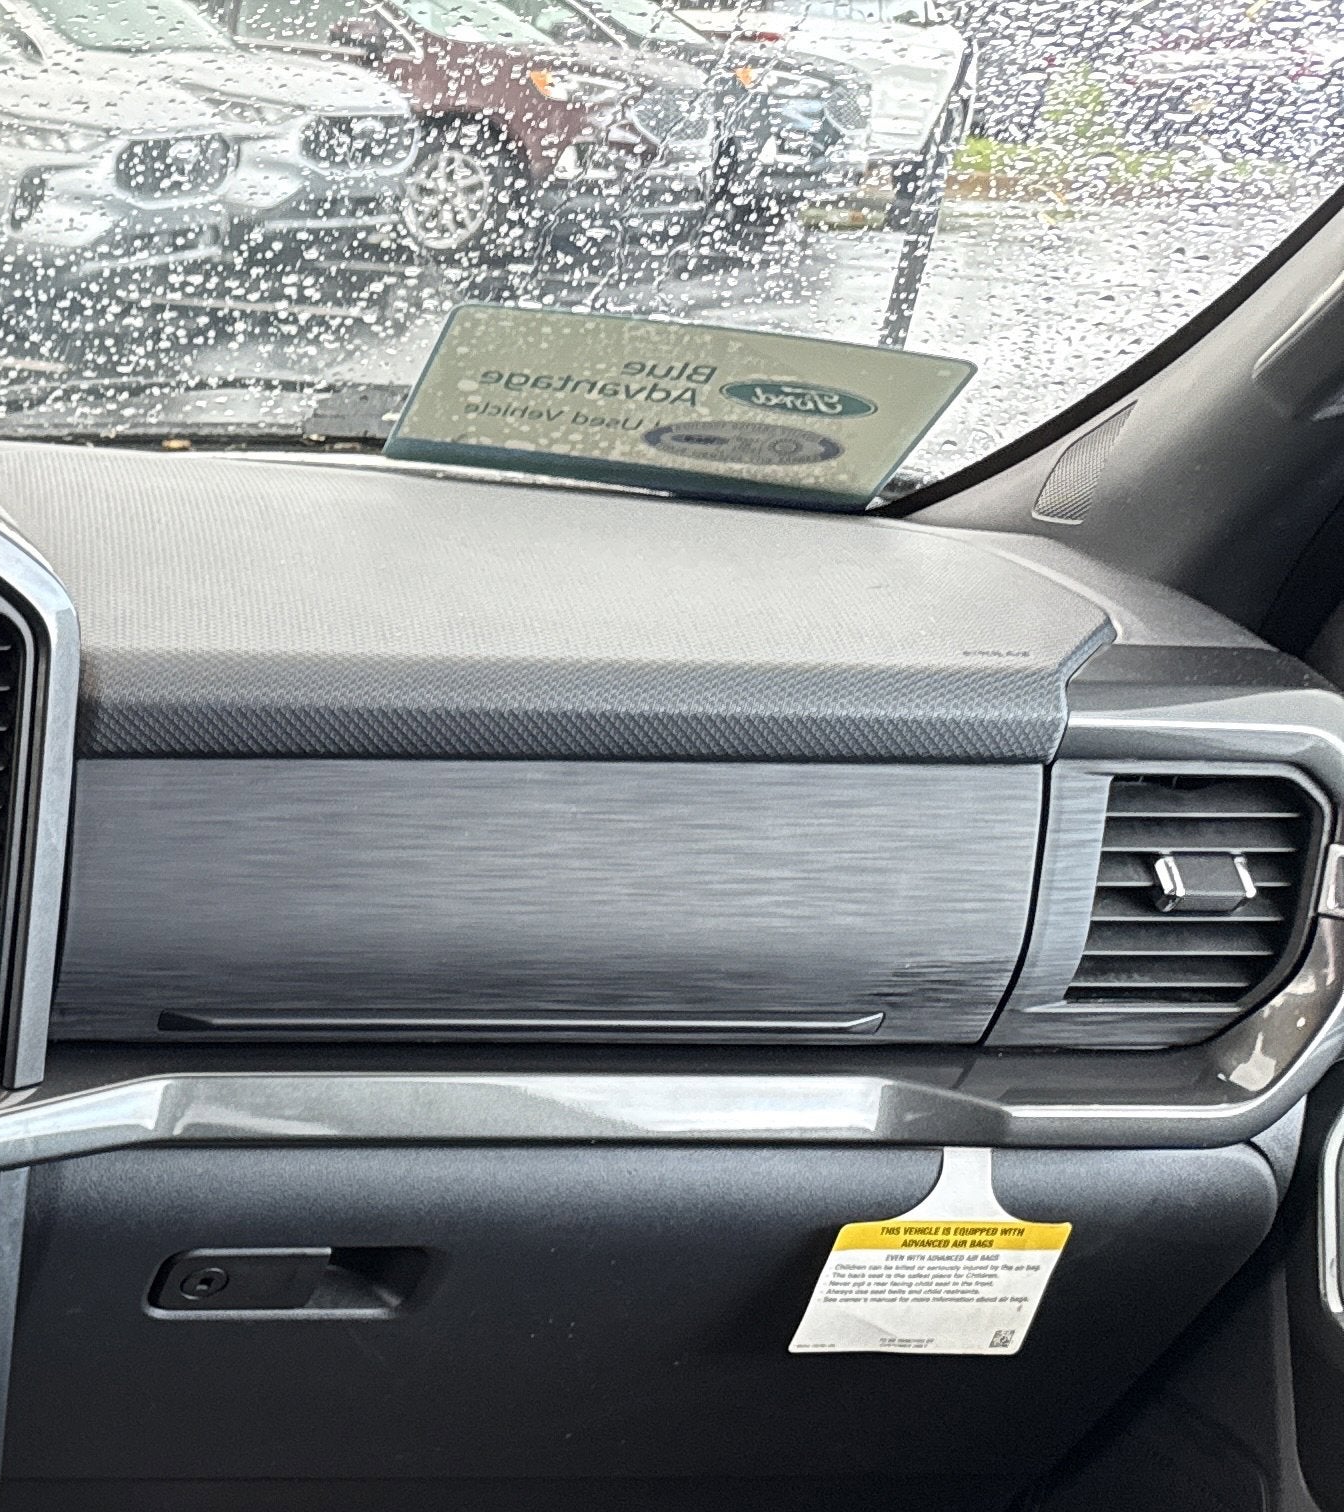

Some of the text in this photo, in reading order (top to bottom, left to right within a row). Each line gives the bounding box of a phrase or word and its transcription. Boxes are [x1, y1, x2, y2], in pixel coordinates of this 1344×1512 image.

[880, 1226, 1025, 1237] THIS VEHICLE IS EQUIPPED WITH
[901, 1239, 994, 1248] ADVANCED AIR BAGS
